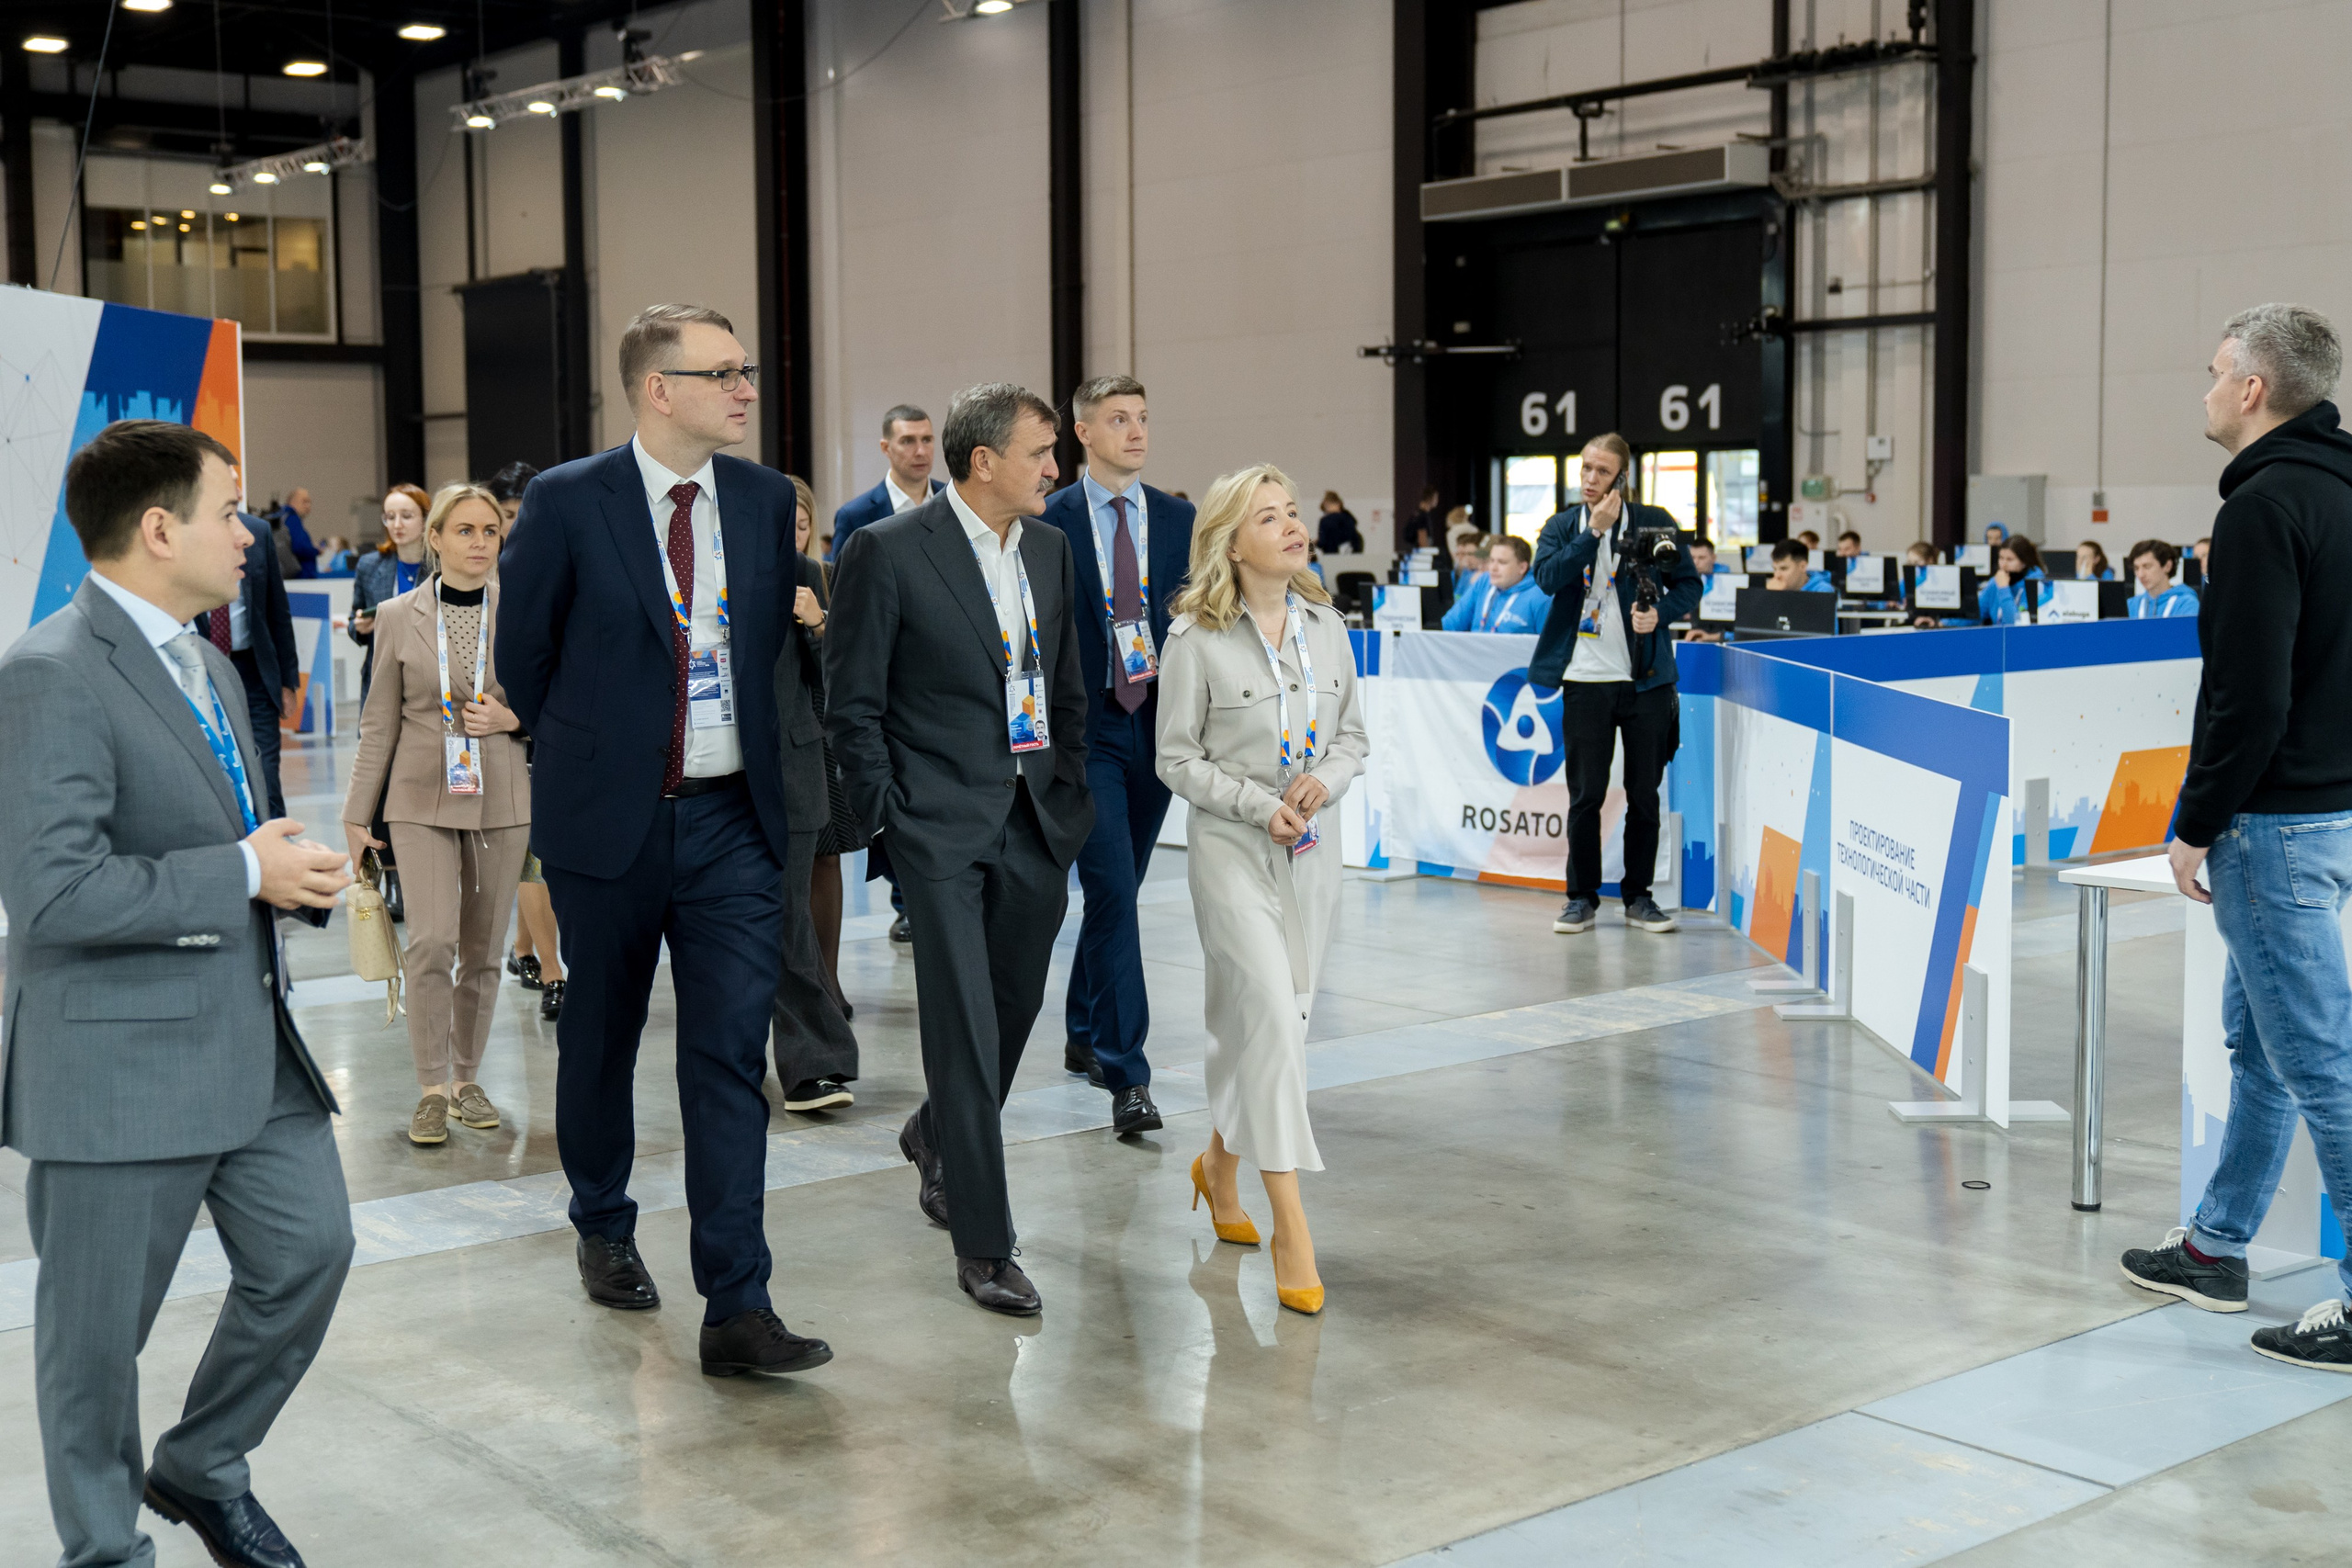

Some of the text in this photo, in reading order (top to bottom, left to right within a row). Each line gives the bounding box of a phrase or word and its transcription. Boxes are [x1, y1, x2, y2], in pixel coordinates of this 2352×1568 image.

[1521, 389, 1577, 437] 61
[1659, 383, 1721, 432] 61
[1462, 805, 1563, 839] ROSATO
[1849, 819, 1916, 871] ПРОЕКТИРОВАНИЕ
[1837, 841, 1931, 909] ТЕХНОЛОГИЧЕСКОЙ ЧАСТИ
